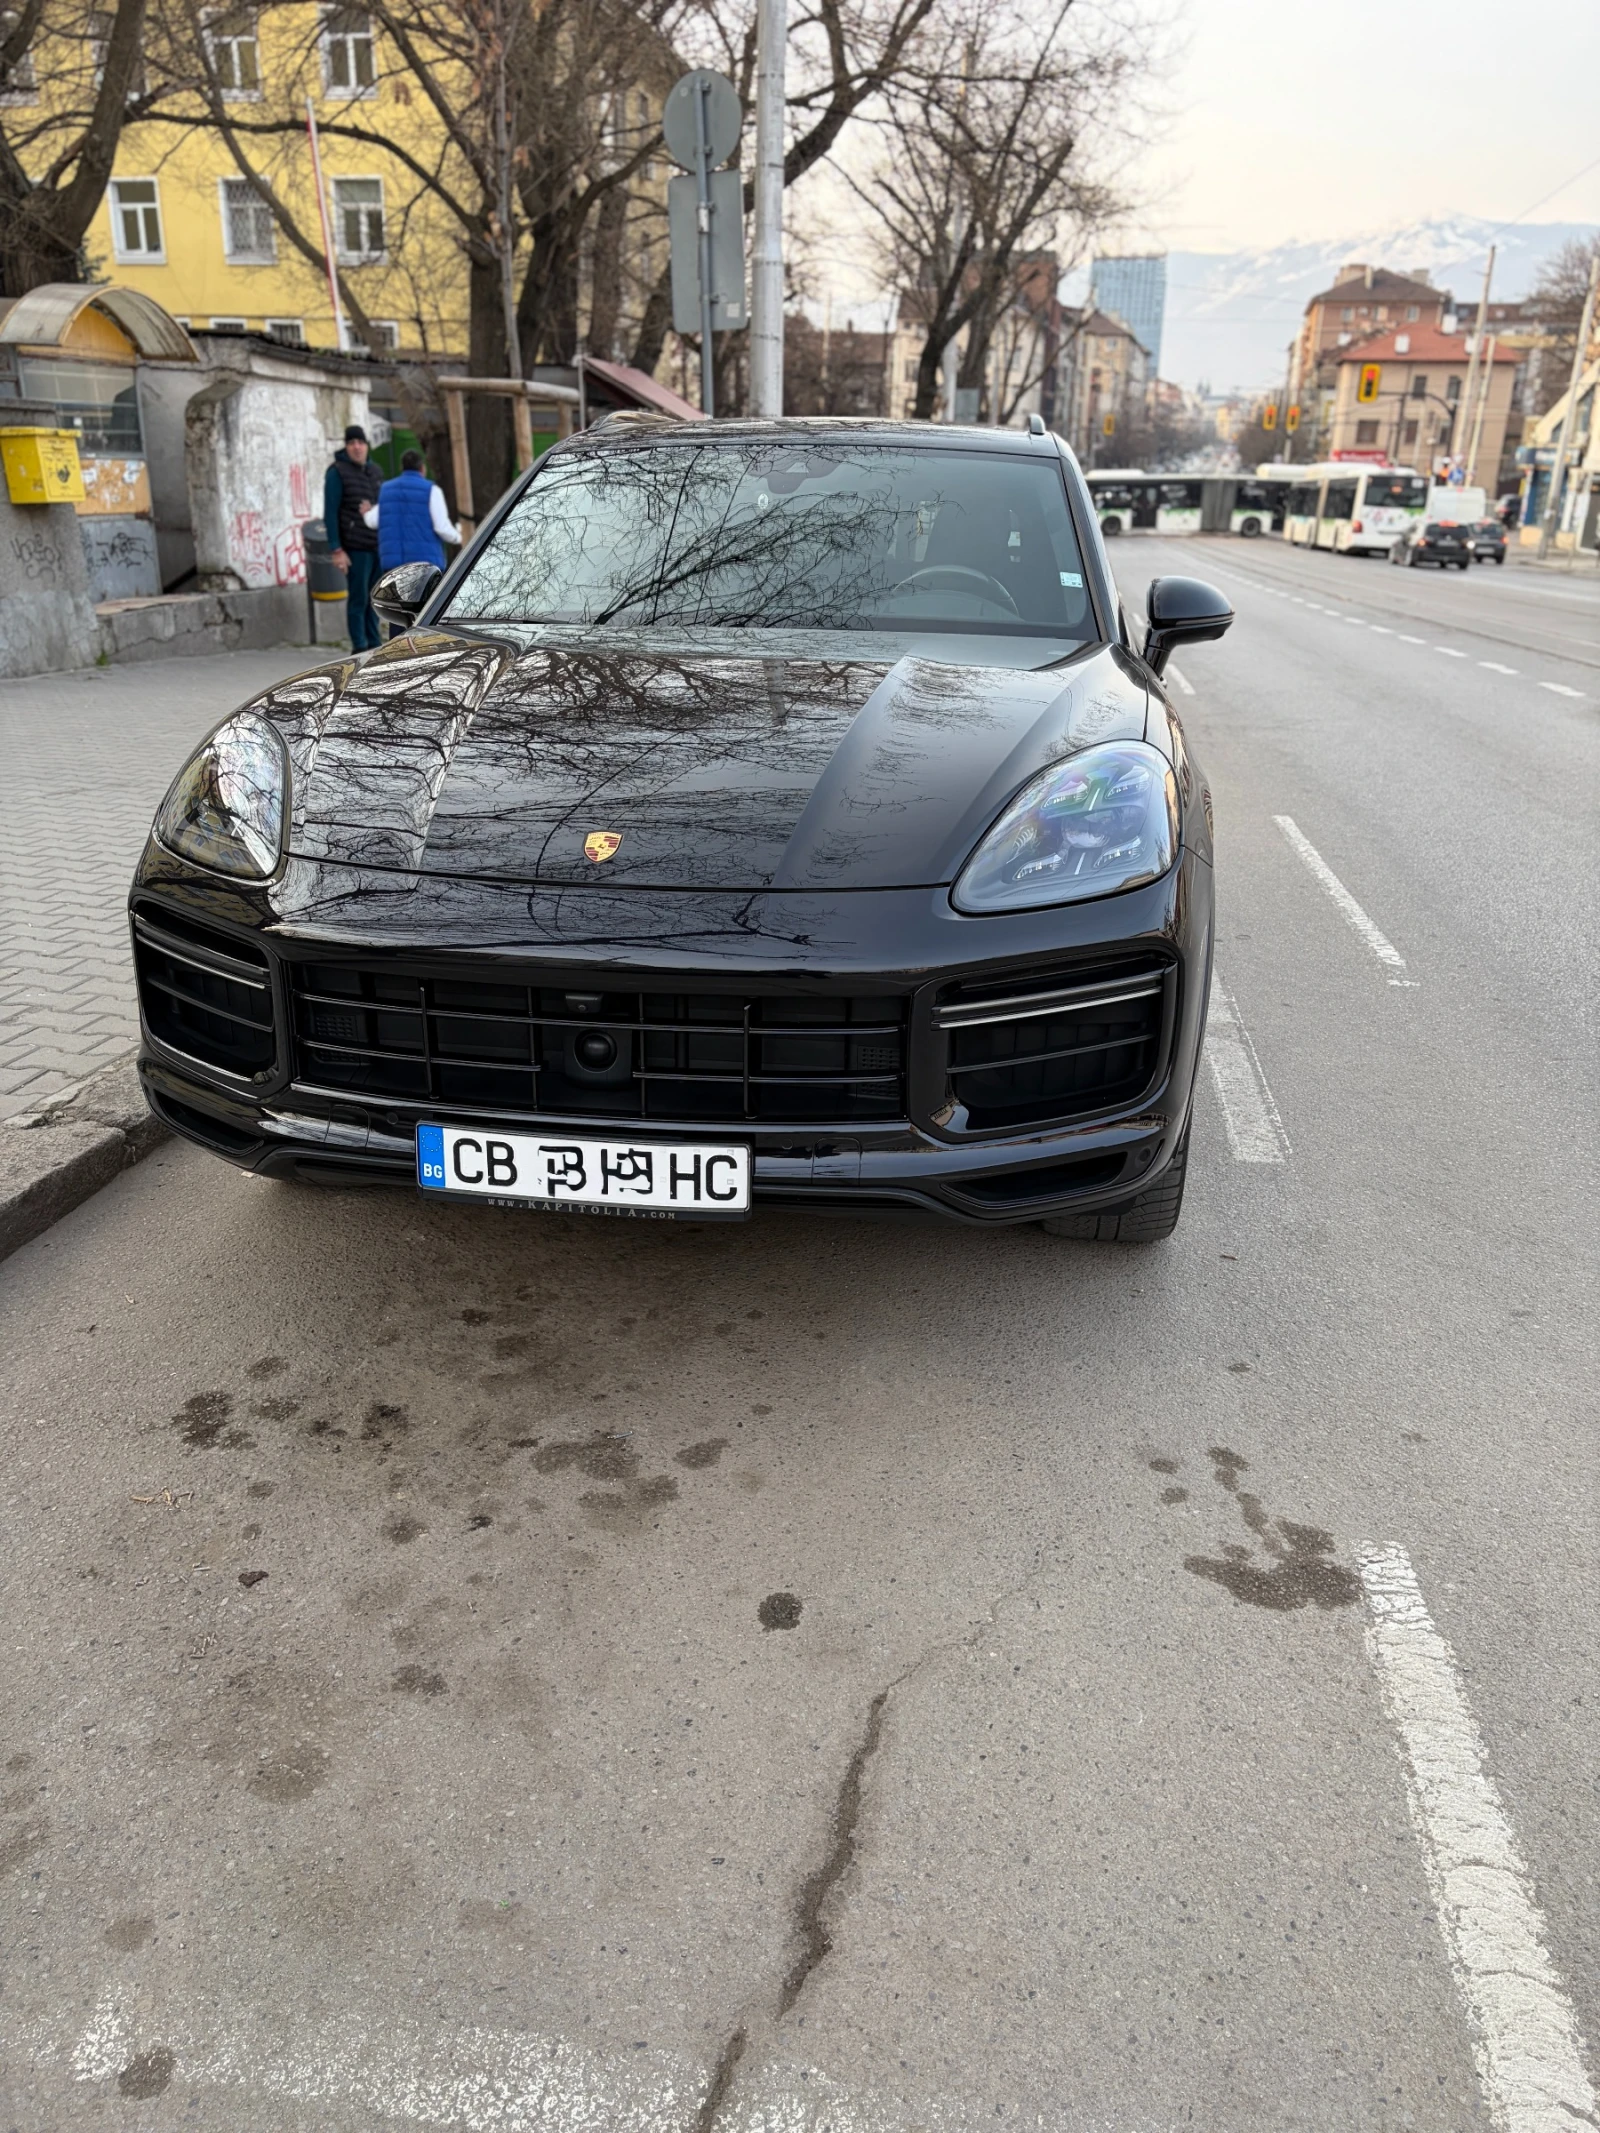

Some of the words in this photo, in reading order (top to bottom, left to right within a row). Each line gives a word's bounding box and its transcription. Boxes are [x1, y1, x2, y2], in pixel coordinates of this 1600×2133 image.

[423, 1162, 443, 1179] BG
[453, 1137, 518, 1187] CB
[669, 1152, 738, 1201] HC
